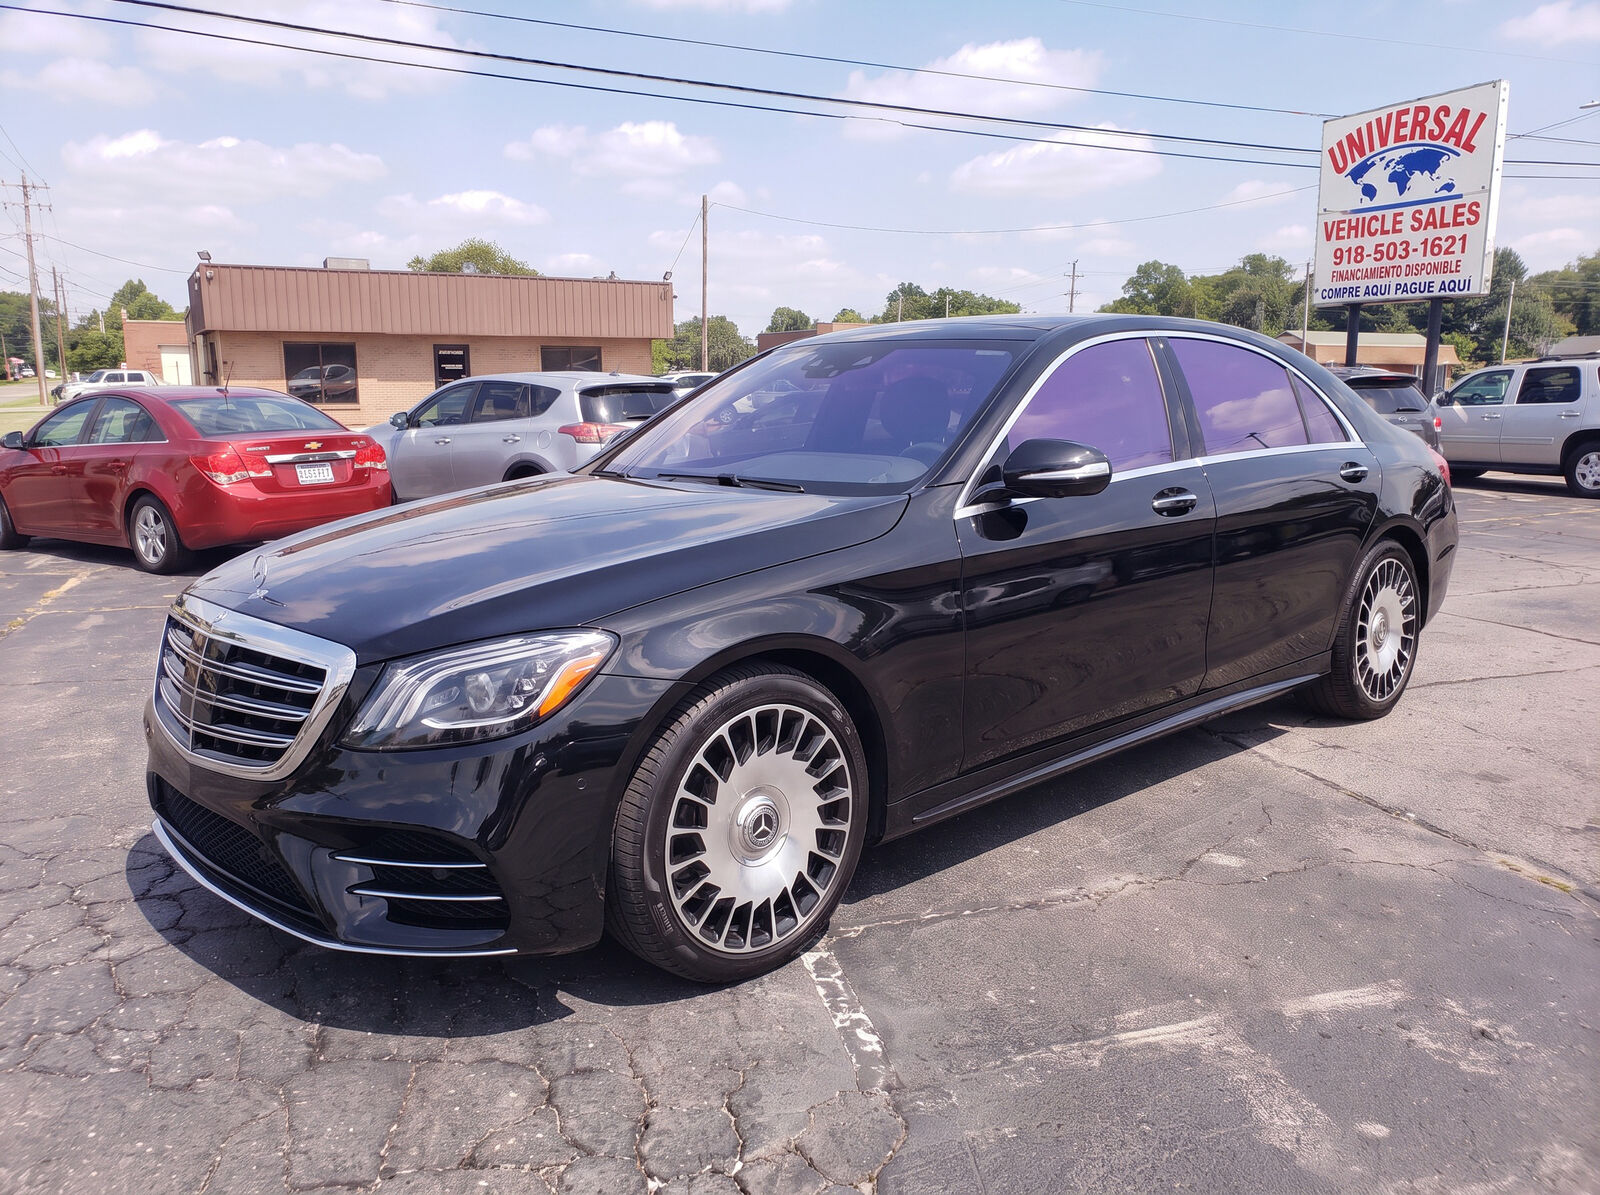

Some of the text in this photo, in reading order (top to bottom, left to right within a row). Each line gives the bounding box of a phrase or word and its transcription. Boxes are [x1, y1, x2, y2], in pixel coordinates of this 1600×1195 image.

[1328, 105, 1487, 174] UNIVERSAL
[1324, 201, 1481, 242] VEHICLE SALES
[1333, 234, 1468, 266] 918-503-1621
[1331, 259, 1461, 282] FINANCIAMIENTO DISPONIBLE
[1321, 275, 1473, 300] COMPRE AQUÍ PAGUE AQUÍ
